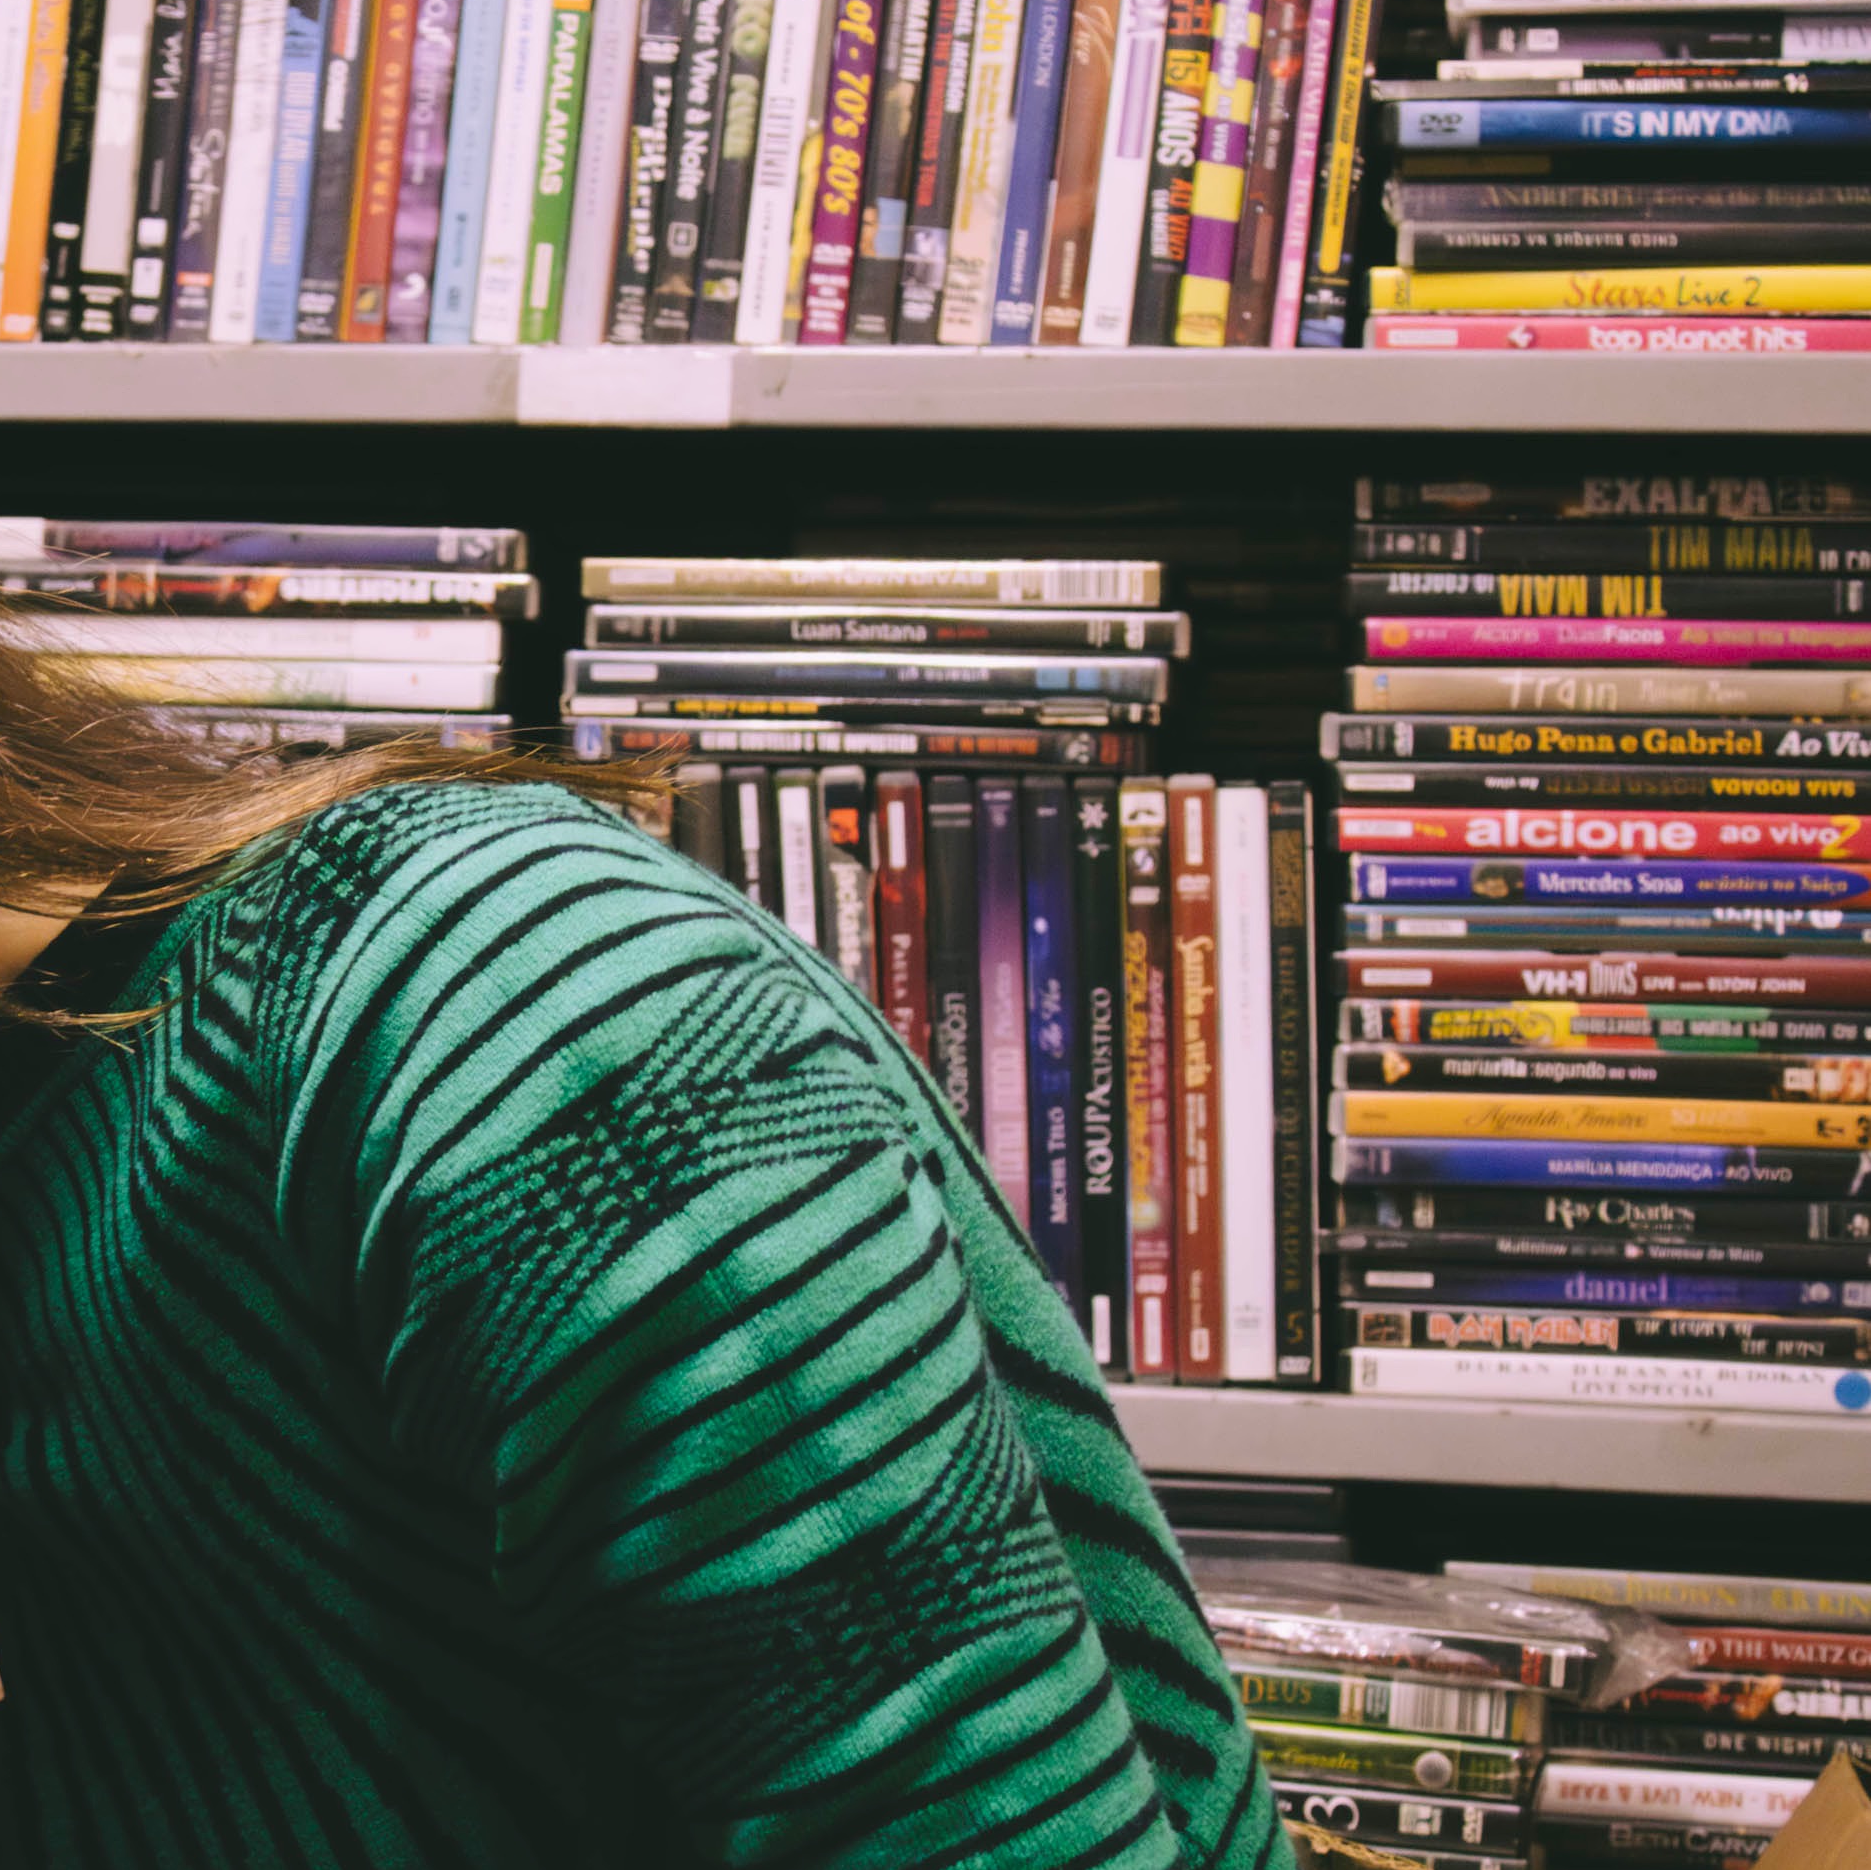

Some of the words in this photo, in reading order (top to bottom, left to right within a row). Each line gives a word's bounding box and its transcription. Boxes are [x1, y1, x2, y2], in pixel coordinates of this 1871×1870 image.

[839, 1, 875, 45] of
[690, 48, 719, 101] Vive
[1168, 49, 1209, 87] 15
[538, 13, 580, 195] PARALAMAS
[830, 69, 870, 139] 70's
[1638, 111, 1669, 136] IN
[1672, 110, 1720, 135] MY
[1726, 110, 1793, 134] DNA
[1156, 93, 1200, 167] ANOS
[676, 127, 709, 201] Noite
[821, 144, 861, 217] 80's
[1563, 274, 1666, 307] Stars
[1676, 274, 1732, 307] Live
[1742, 277, 1762, 305] 2
[1588, 327, 1646, 353] top
[1648, 327, 1746, 353] planet
[1756, 327, 1807, 351] hits
[1499, 575, 1588, 617] MAIA
[1600, 575, 1667, 617] TIM
[792, 619, 844, 643] Luan
[849, 619, 928, 643] Santana
[1498, 672, 1619, 708] Train
[1449, 726, 1532, 757] Hugo
[1536, 727, 1615, 754] Pena
[1620, 733, 1638, 754] e
[1643, 727, 1763, 756] Gabriel
[1776, 731, 1821, 756] Ao
[1826, 731, 1871, 757] Viv
[1464, 811, 1698, 851] alcione
[1719, 824, 1761, 844] ao
[1768, 823, 1840, 845] vivo
[1825, 815, 1861, 859] 2
[1537, 872, 1632, 895] Mercedes
[1636, 873, 1684, 895] Sosa
[1764, 1640, 1843, 1664] WALTZ
[1754, 1733, 1823, 1756] NIGHT
[1682, 1824, 1772, 1857] CARVA
